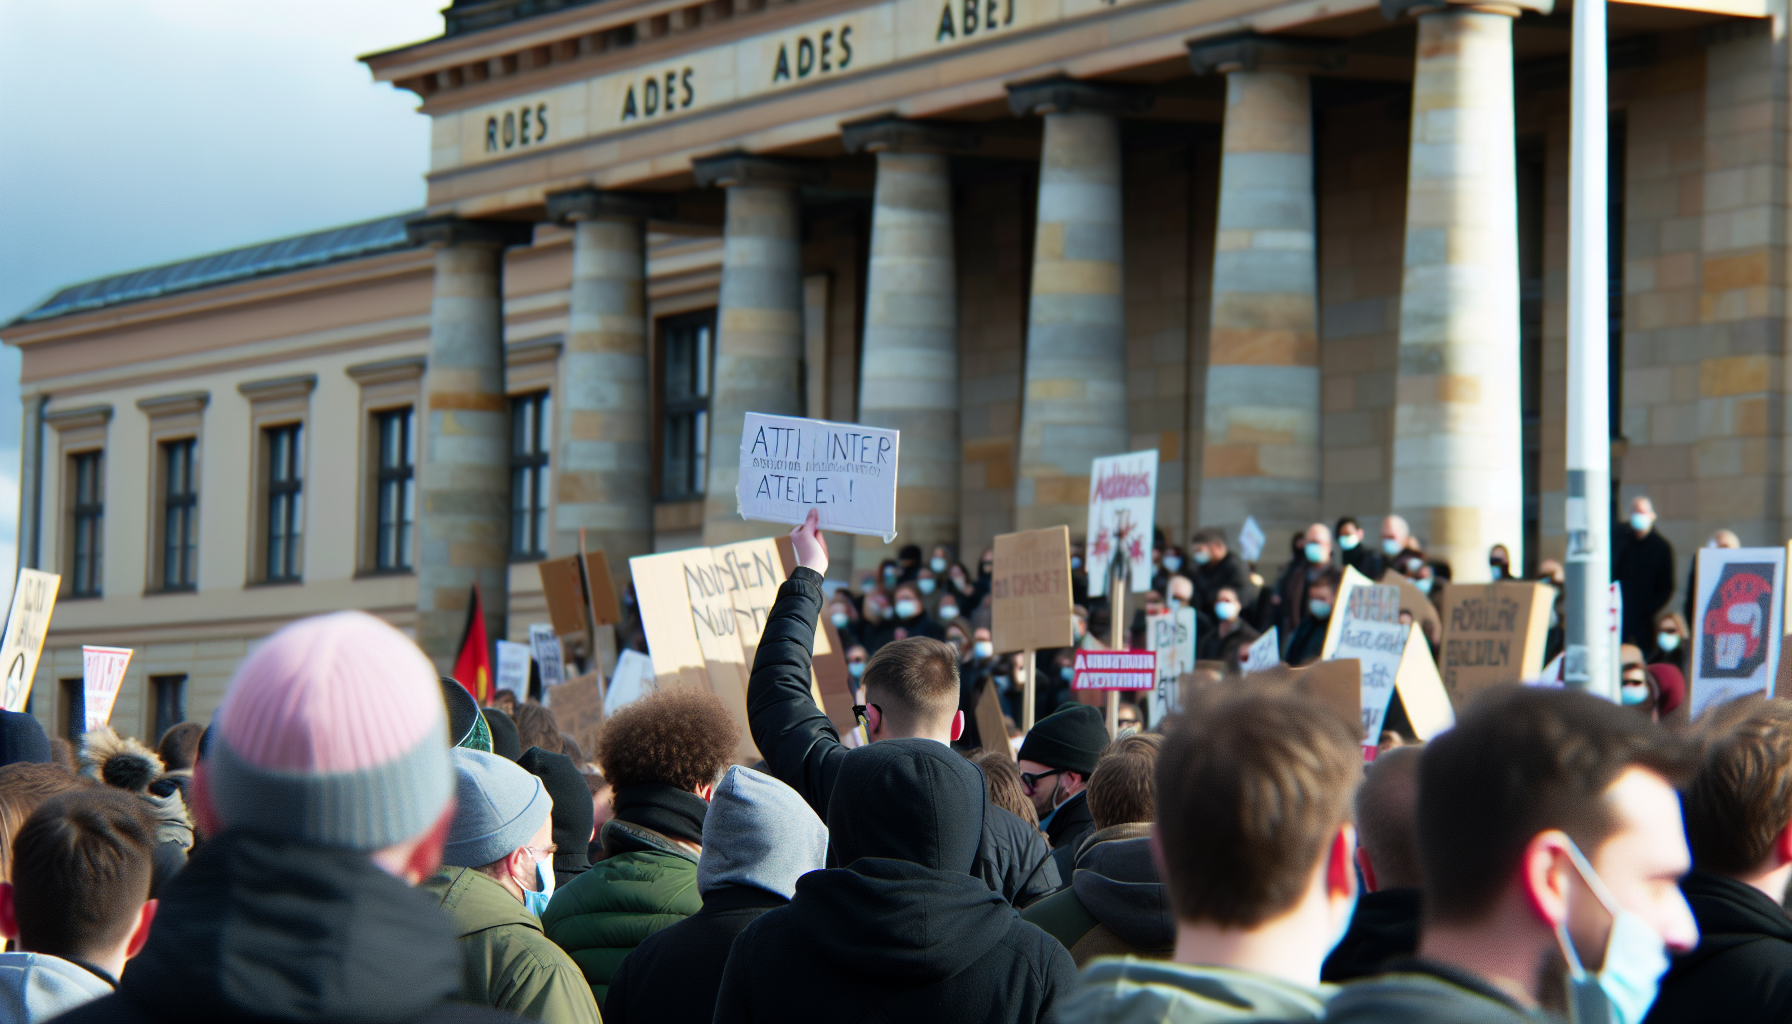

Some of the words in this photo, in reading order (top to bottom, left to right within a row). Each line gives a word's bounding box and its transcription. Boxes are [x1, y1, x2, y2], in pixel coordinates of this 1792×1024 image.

[486, 104, 548, 152] ROES
[620, 65, 695, 121] ADES
[773, 24, 853, 82] ADES
